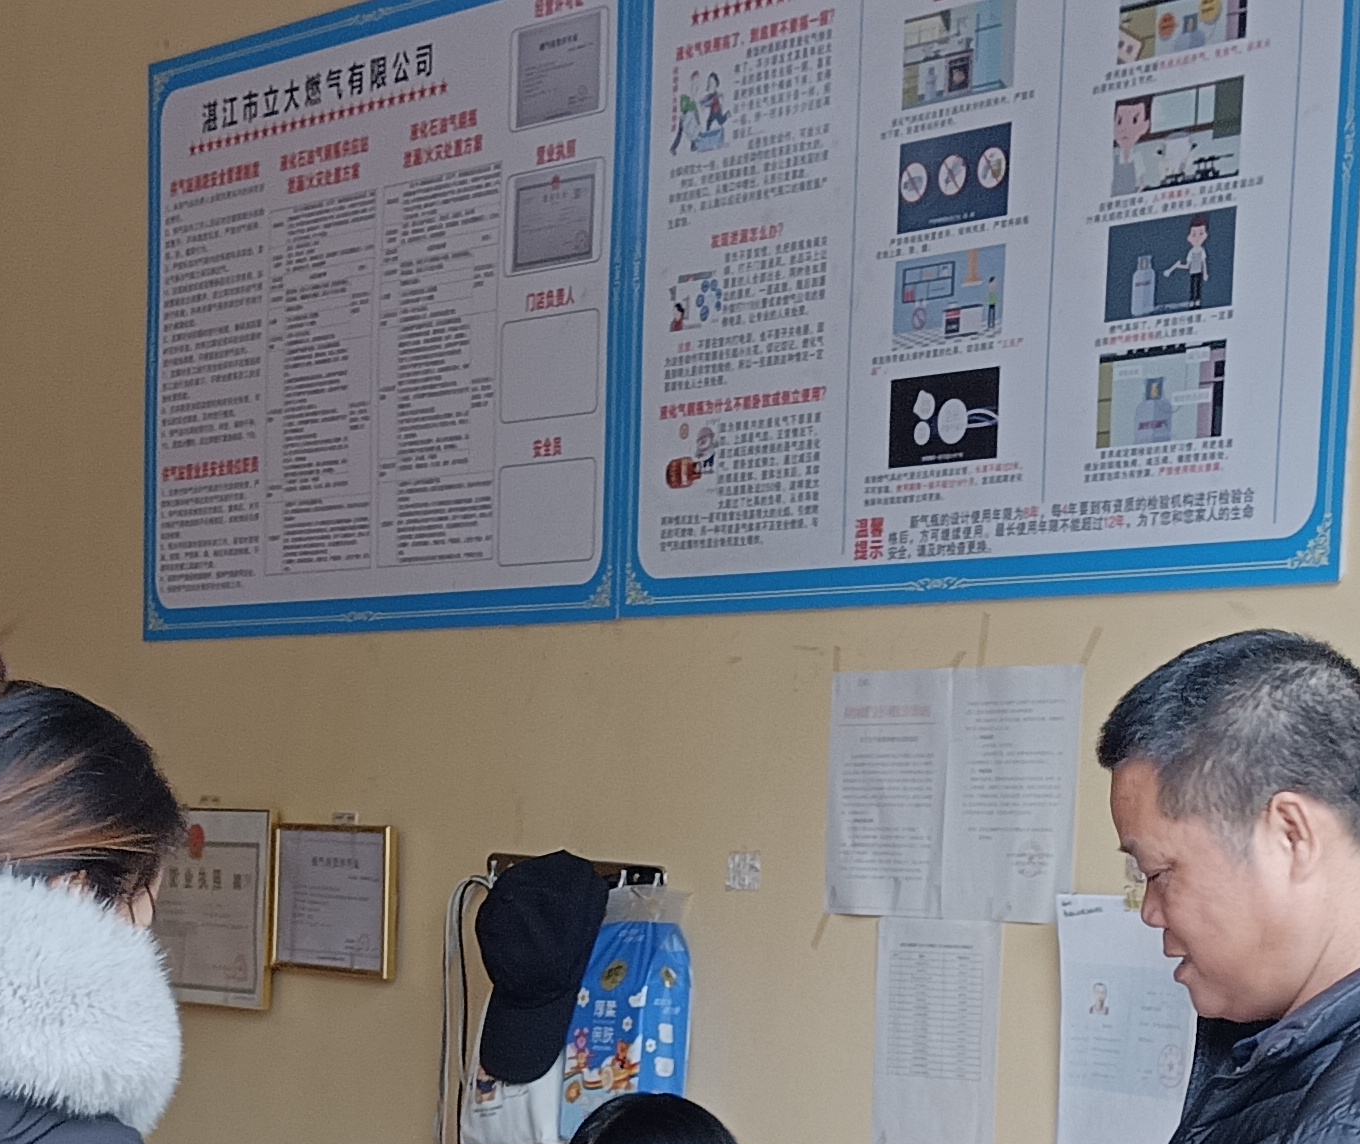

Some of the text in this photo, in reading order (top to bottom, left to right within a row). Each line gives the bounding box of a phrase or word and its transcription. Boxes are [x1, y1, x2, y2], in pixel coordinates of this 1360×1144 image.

[202, 43, 435, 134] 湛江市立大燃气有限公司
